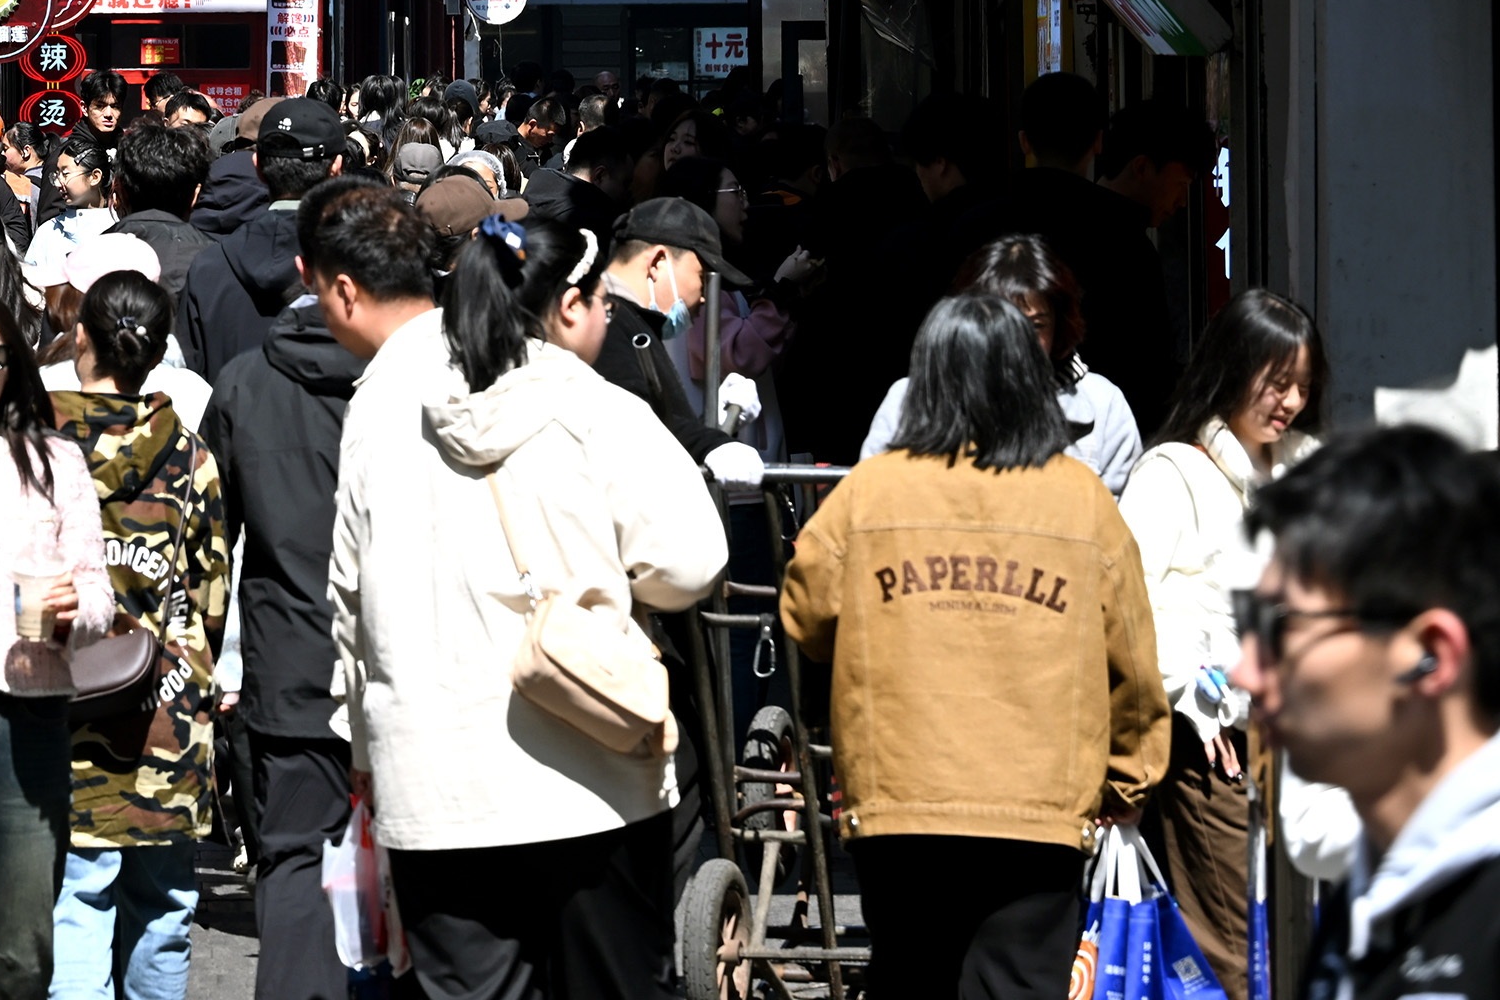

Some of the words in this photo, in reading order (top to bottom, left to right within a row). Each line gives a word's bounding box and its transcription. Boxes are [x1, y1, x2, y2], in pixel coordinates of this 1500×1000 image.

[40, 42, 68, 72] 辣
[705, 32, 744, 60] 十元
[39, 99, 67, 127] 烫
[874, 555, 1068, 614] PAPERLLL
